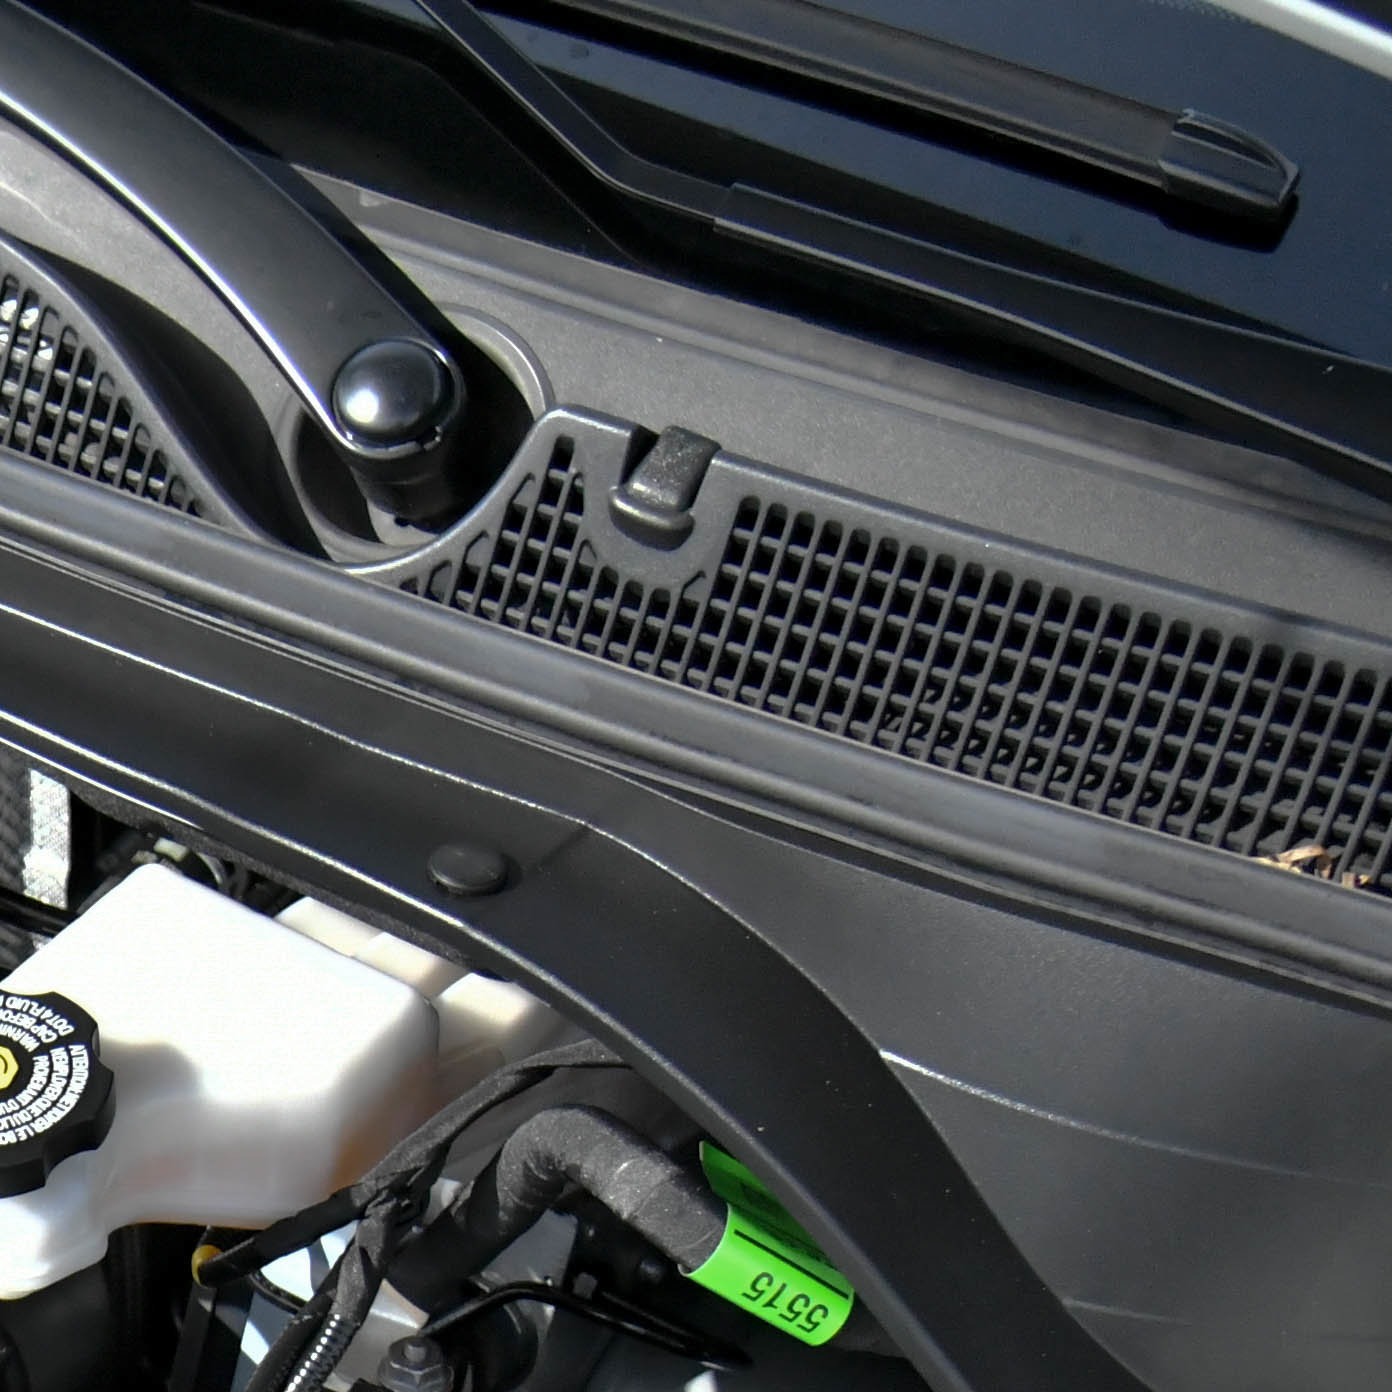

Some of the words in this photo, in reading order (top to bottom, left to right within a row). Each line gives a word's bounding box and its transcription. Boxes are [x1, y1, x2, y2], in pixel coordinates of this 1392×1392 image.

[5, 996, 46, 1017] FLUID
[30, 1024, 57, 1043] CAP
[14, 1125, 34, 1141] LE
[741, 1271, 829, 1333] 5515
